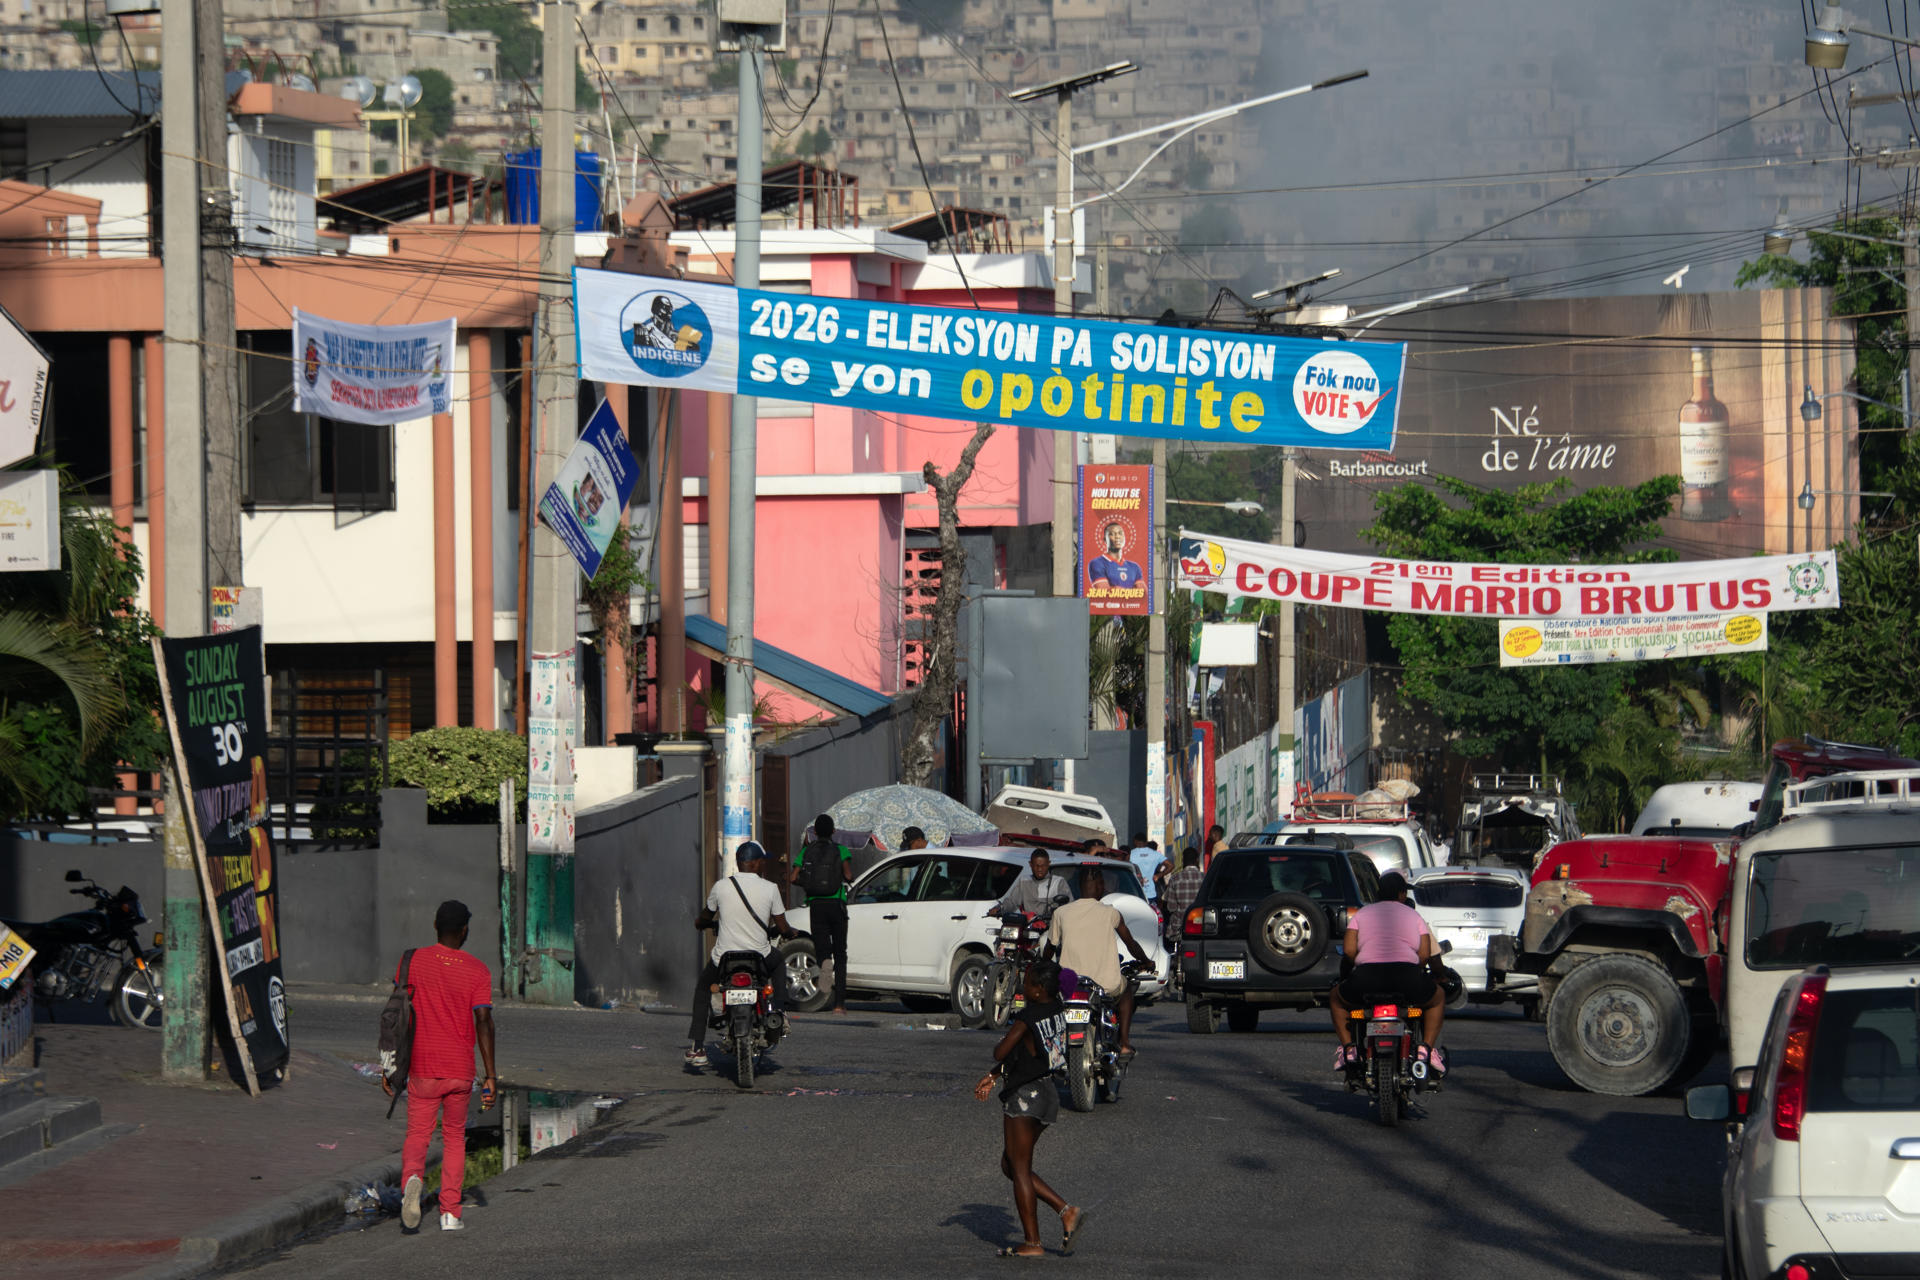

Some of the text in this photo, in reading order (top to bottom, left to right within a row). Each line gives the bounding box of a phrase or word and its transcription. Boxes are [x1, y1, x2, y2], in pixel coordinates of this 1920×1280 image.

[750, 299, 840, 343] 2026
[866, 308, 1039, 363] ELEKSYON
[1051, 326, 1093, 368] PA
[1110, 331, 1276, 381] SOLISYON
[632, 346, 702, 363] INDIGENE
[1305, 365, 1377, 393] Fòk nou
[750, 353, 1265, 433] se yon opòtinite
[1302, 390, 1348, 419] VOTE
[1491, 404, 1539, 437] Né
[1482, 431, 1617, 471] de l'âme
[1329, 459, 1429, 477] Barbancourt
[1091, 498, 1141, 510] GRENADYE
[1109, 488, 1128, 498] TOUT
[1129, 488, 1140, 498] SE
[1472, 567, 1631, 584] Edition
[1086, 588, 1145, 599] JEAN-JACQUES
[1235, 563, 1393, 607] COUPE
[1411, 582, 1561, 614] MARIO
[1580, 578, 1772, 615] BRUTUS
[1544, 618, 1597, 628] Observatoire
[1616, 623, 1663, 637] Championnat
[1682, 630, 1723, 644] SOCIALE
[185, 643, 240, 687] SUNDAY
[188, 682, 245, 728] AUGUST
